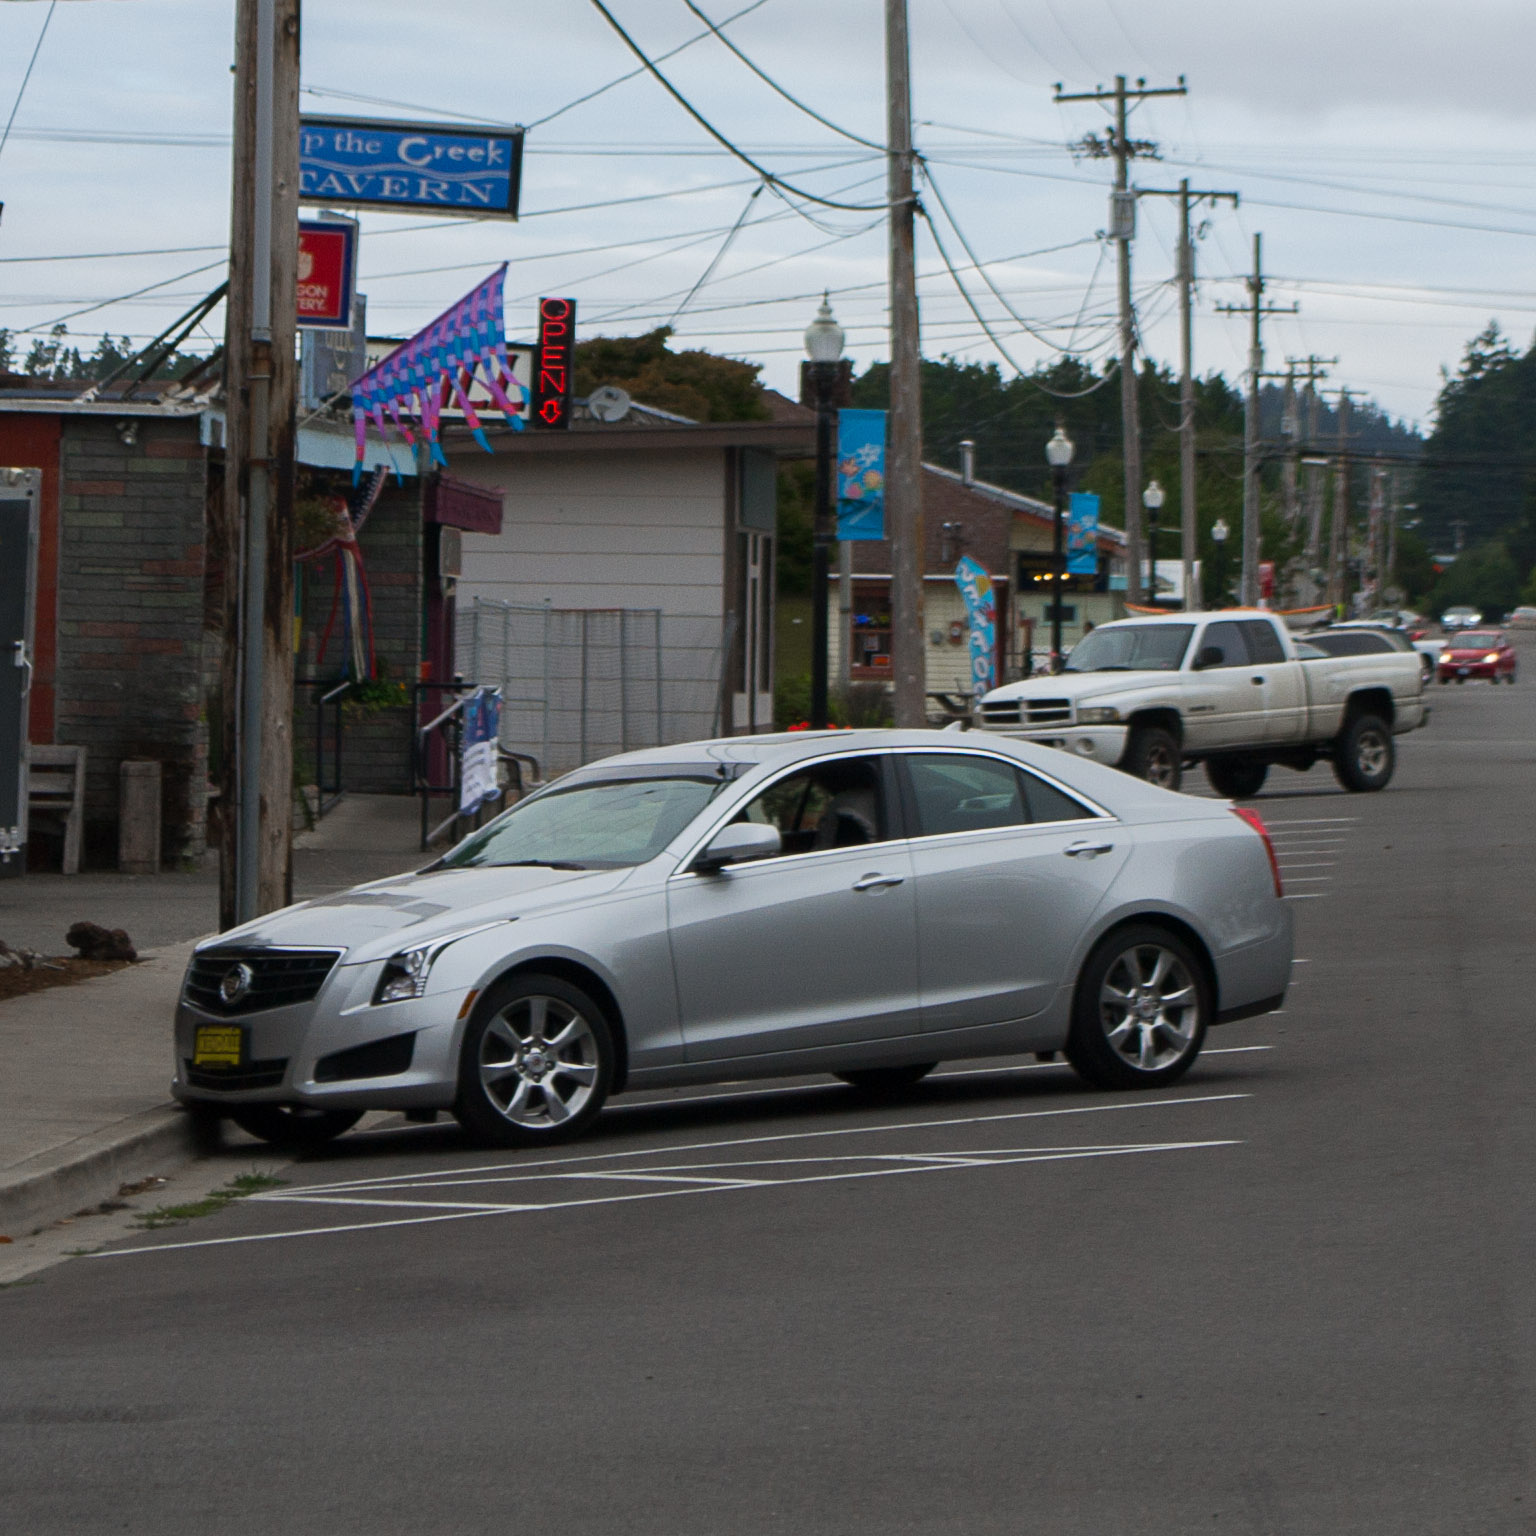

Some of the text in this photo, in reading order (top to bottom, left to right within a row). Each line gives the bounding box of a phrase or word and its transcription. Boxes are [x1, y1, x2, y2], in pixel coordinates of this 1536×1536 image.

[334, 131, 382, 155] the
[397, 136, 505, 166] Creek
[300, 170, 495, 204] TAVERN
[540, 297, 570, 394] OPEN
[960, 562, 990, 702] SEAFOO
